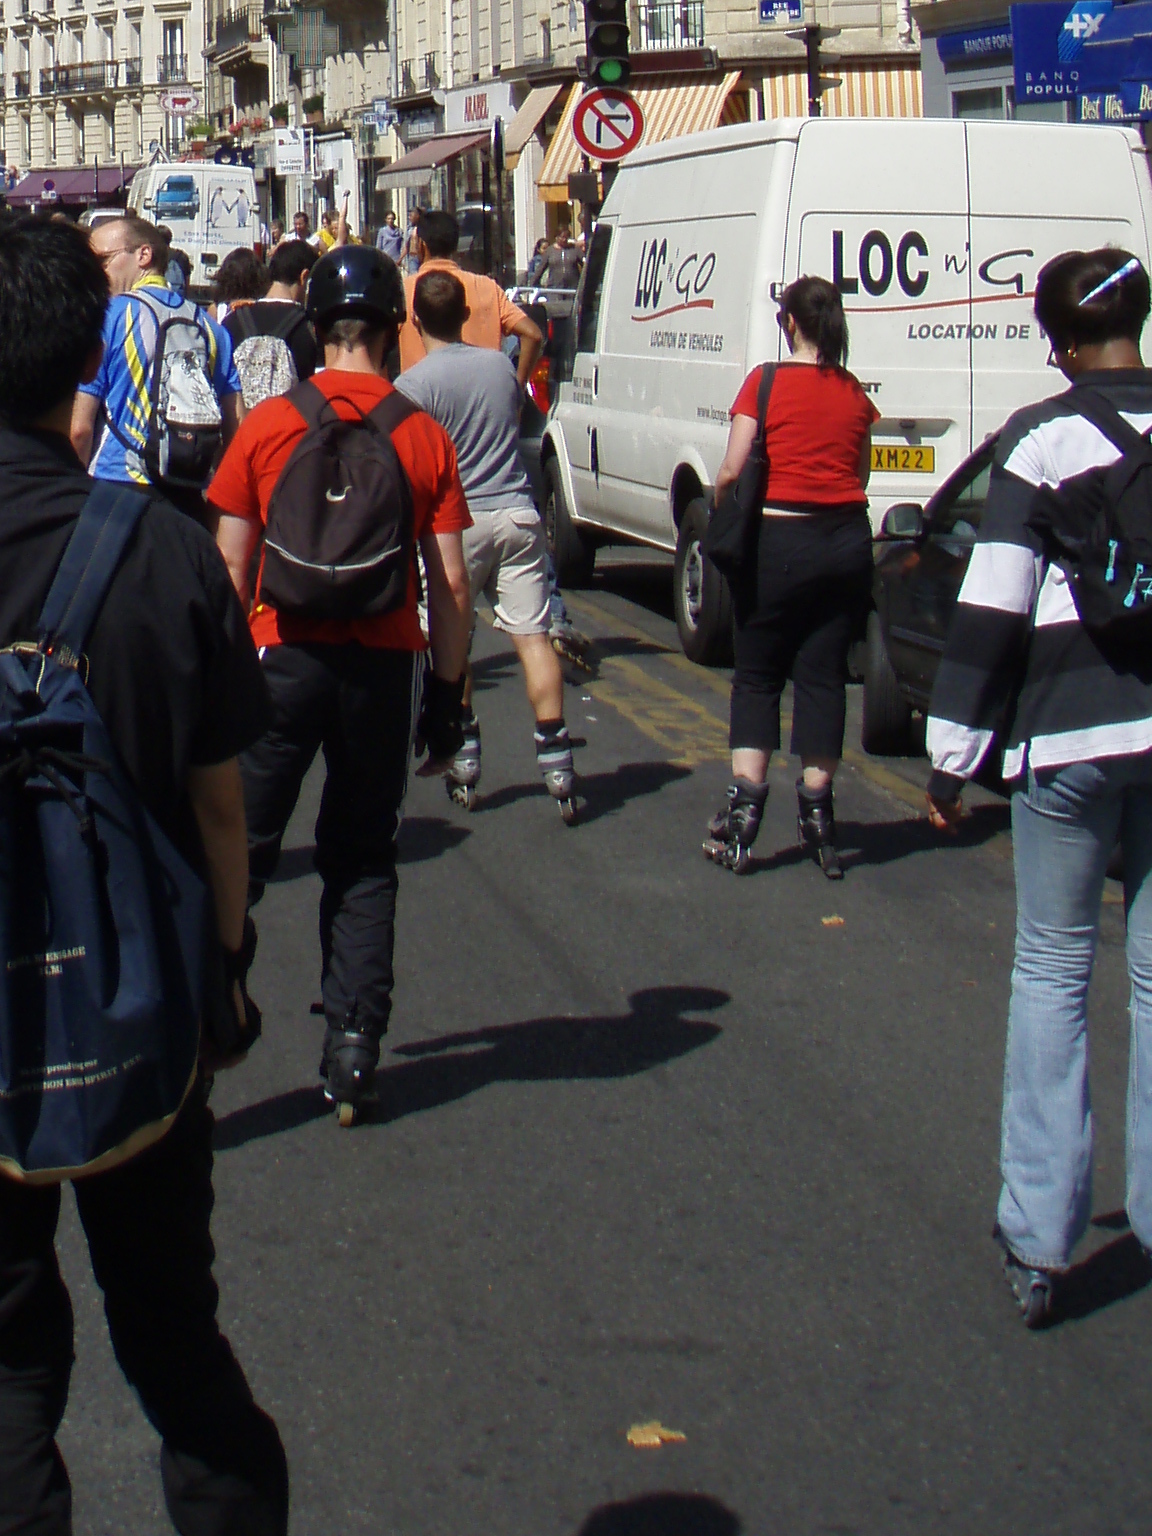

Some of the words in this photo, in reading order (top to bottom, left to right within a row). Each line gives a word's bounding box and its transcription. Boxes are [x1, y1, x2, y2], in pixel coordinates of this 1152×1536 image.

[1025, 70, 1079, 82] BANQ
[1081, 95, 1100, 120] Best
[634, 238, 667, 310] LOC
[676, 252, 716, 307] GO
[834, 229, 930, 297] LOC
[978, 249, 1035, 295] G
[650, 330, 677, 349] LOCATION
[677, 332, 688, 350] DE
[688, 332, 723, 352] VEHICULES
[907, 324, 998, 340] LOCATION
[1004, 325, 1031, 340] DE
